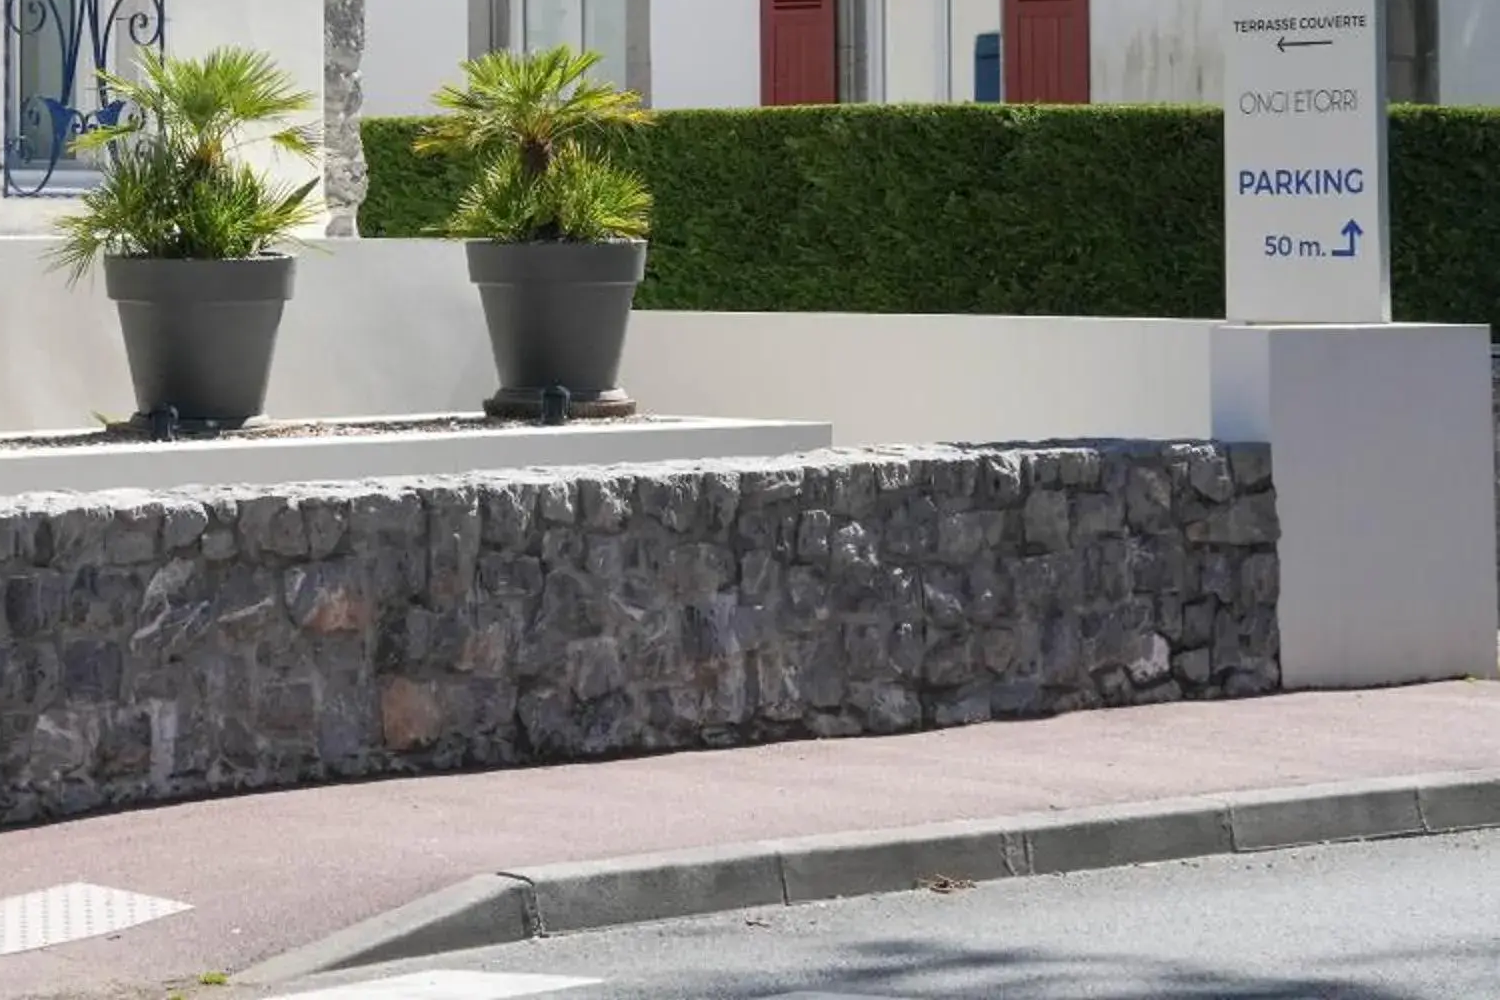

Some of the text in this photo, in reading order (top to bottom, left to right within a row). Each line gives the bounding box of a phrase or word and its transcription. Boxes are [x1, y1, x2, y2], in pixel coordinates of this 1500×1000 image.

[1233, 14, 1367, 33] TERRASSE COUVERTE
[1239, 168, 1364, 196] PARKING
[1264, 235, 1327, 257] 50 m.
